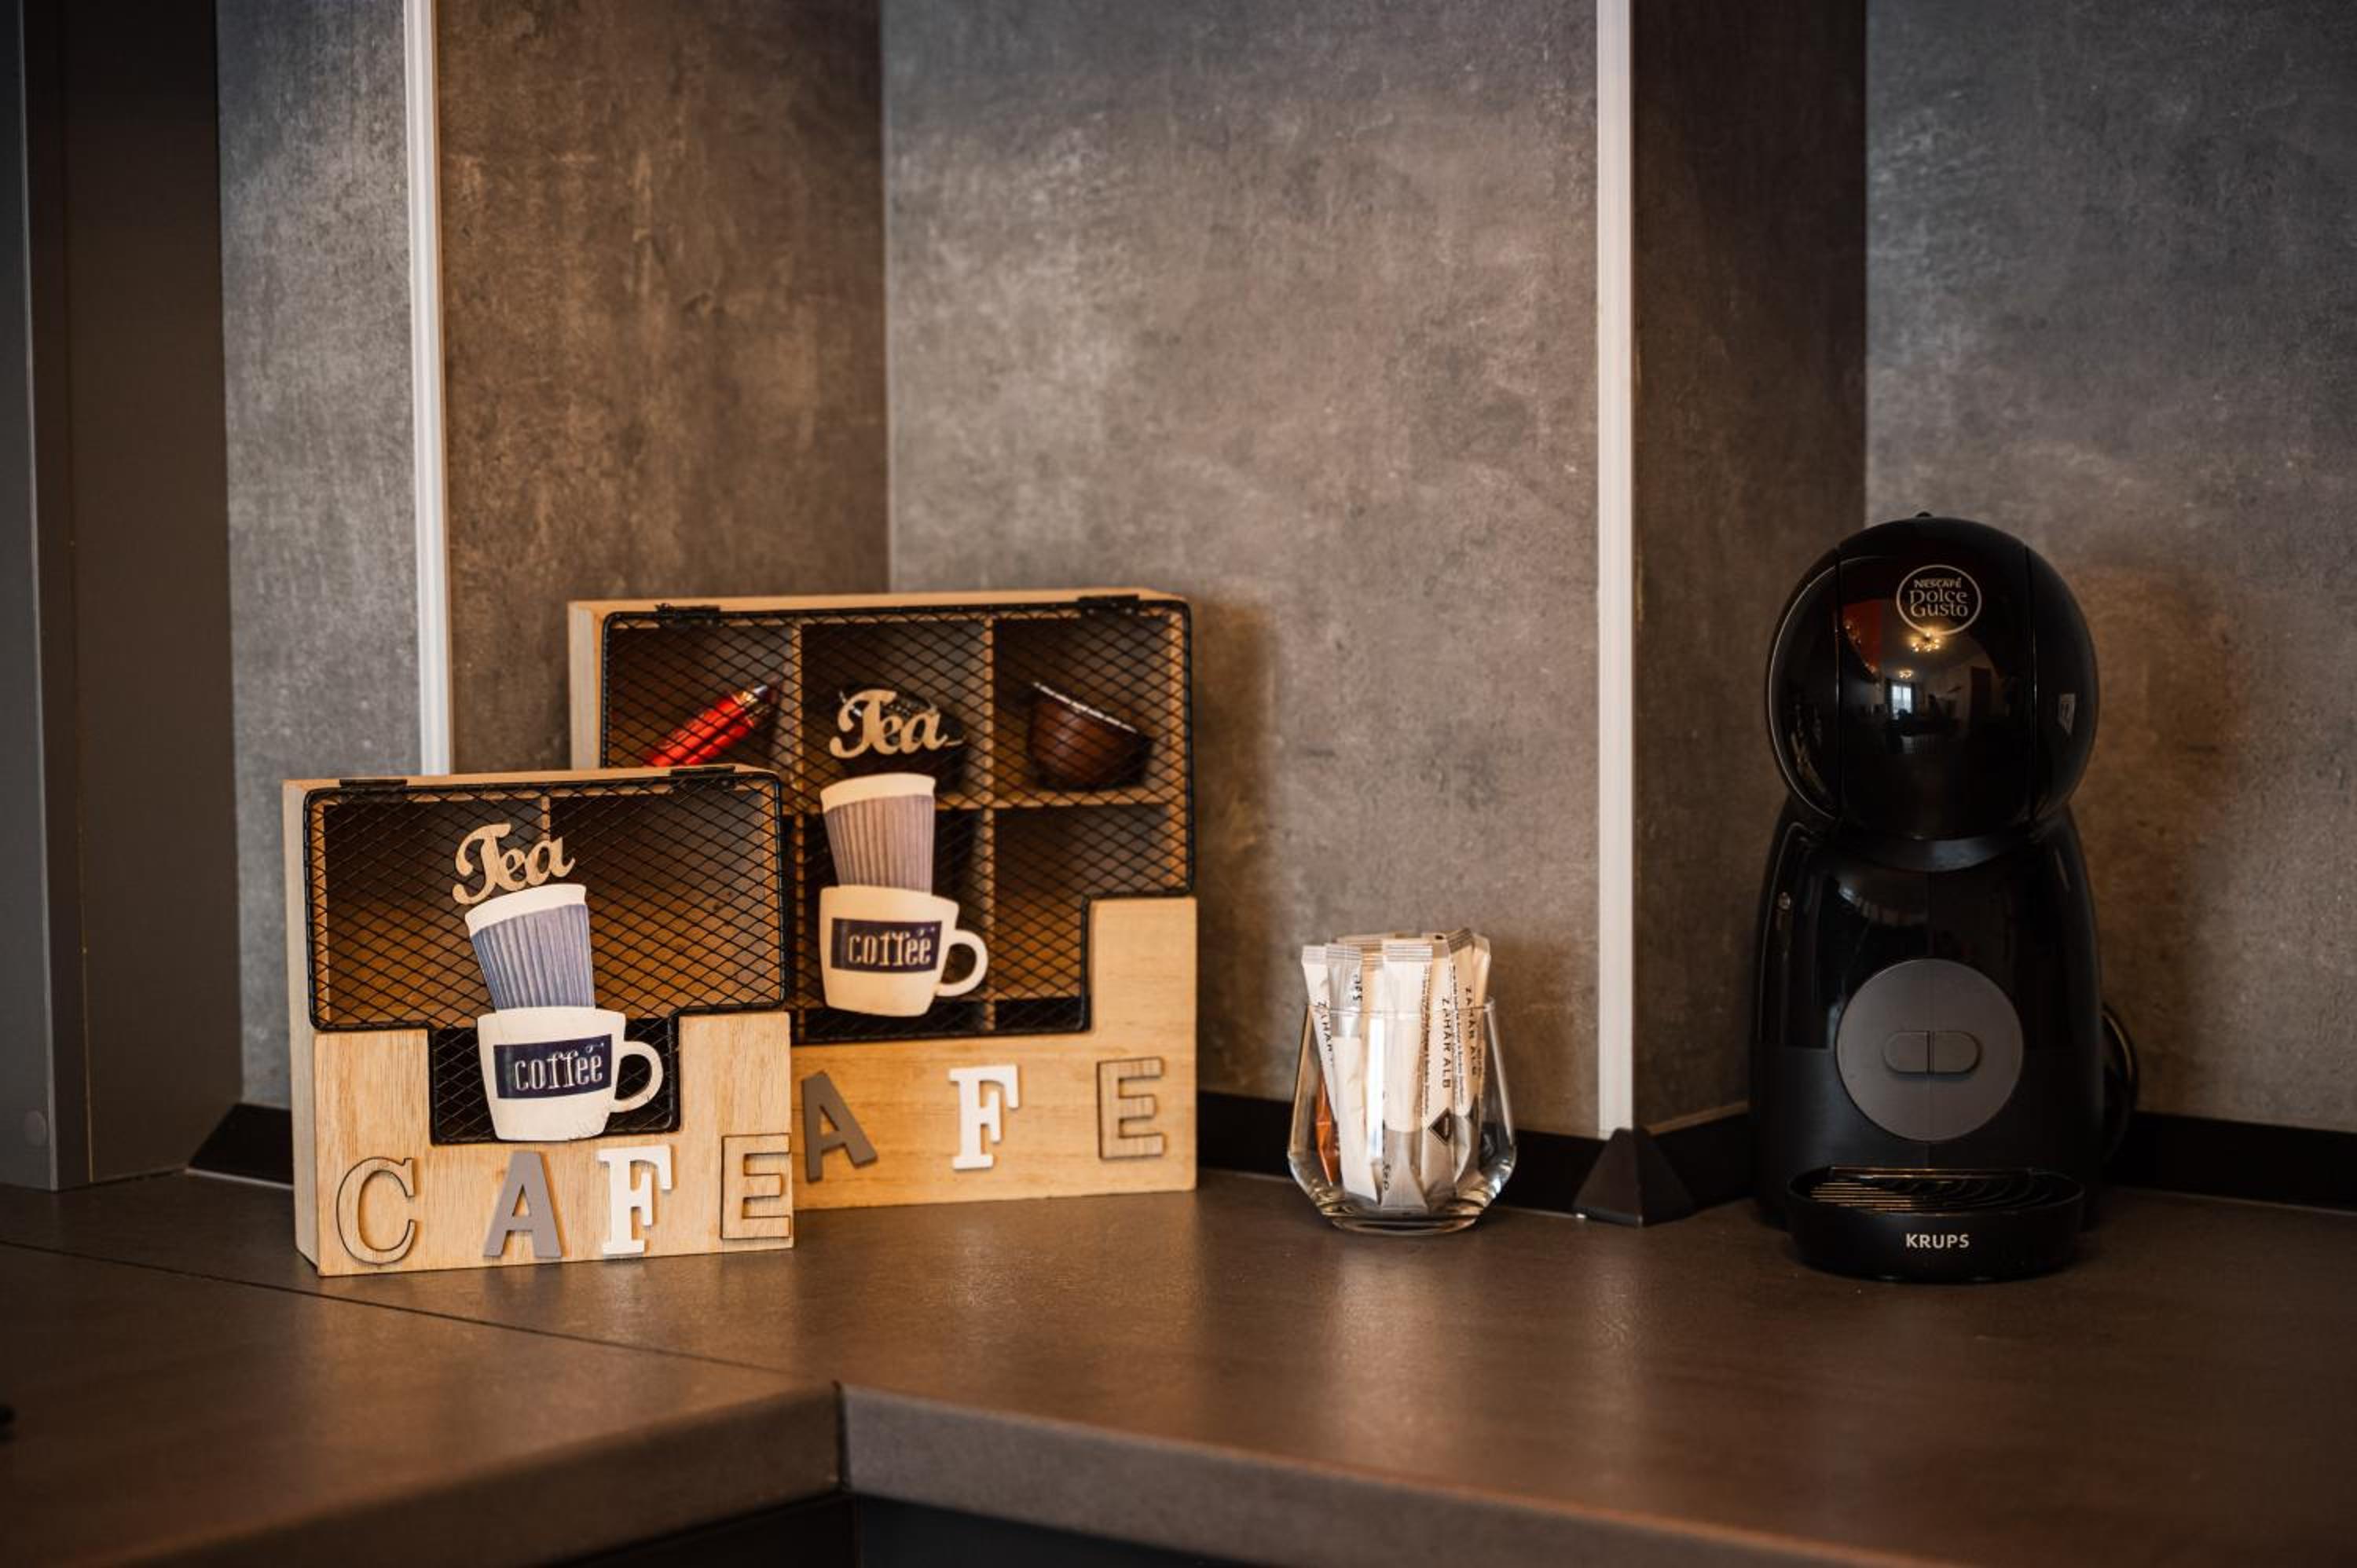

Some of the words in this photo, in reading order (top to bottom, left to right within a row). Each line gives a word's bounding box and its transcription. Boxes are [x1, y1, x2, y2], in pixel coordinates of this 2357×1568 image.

[1913, 577, 1963, 588] NESCAFÉ
[1909, 588, 1968, 604] Dolce
[1910, 603, 1969, 617] Gusto
[830, 688, 952, 760] Tea
[451, 822, 576, 905] Tea
[800, 1056, 1166, 1183] AFE
[1905, 1233, 1970, 1250] KRUPS
